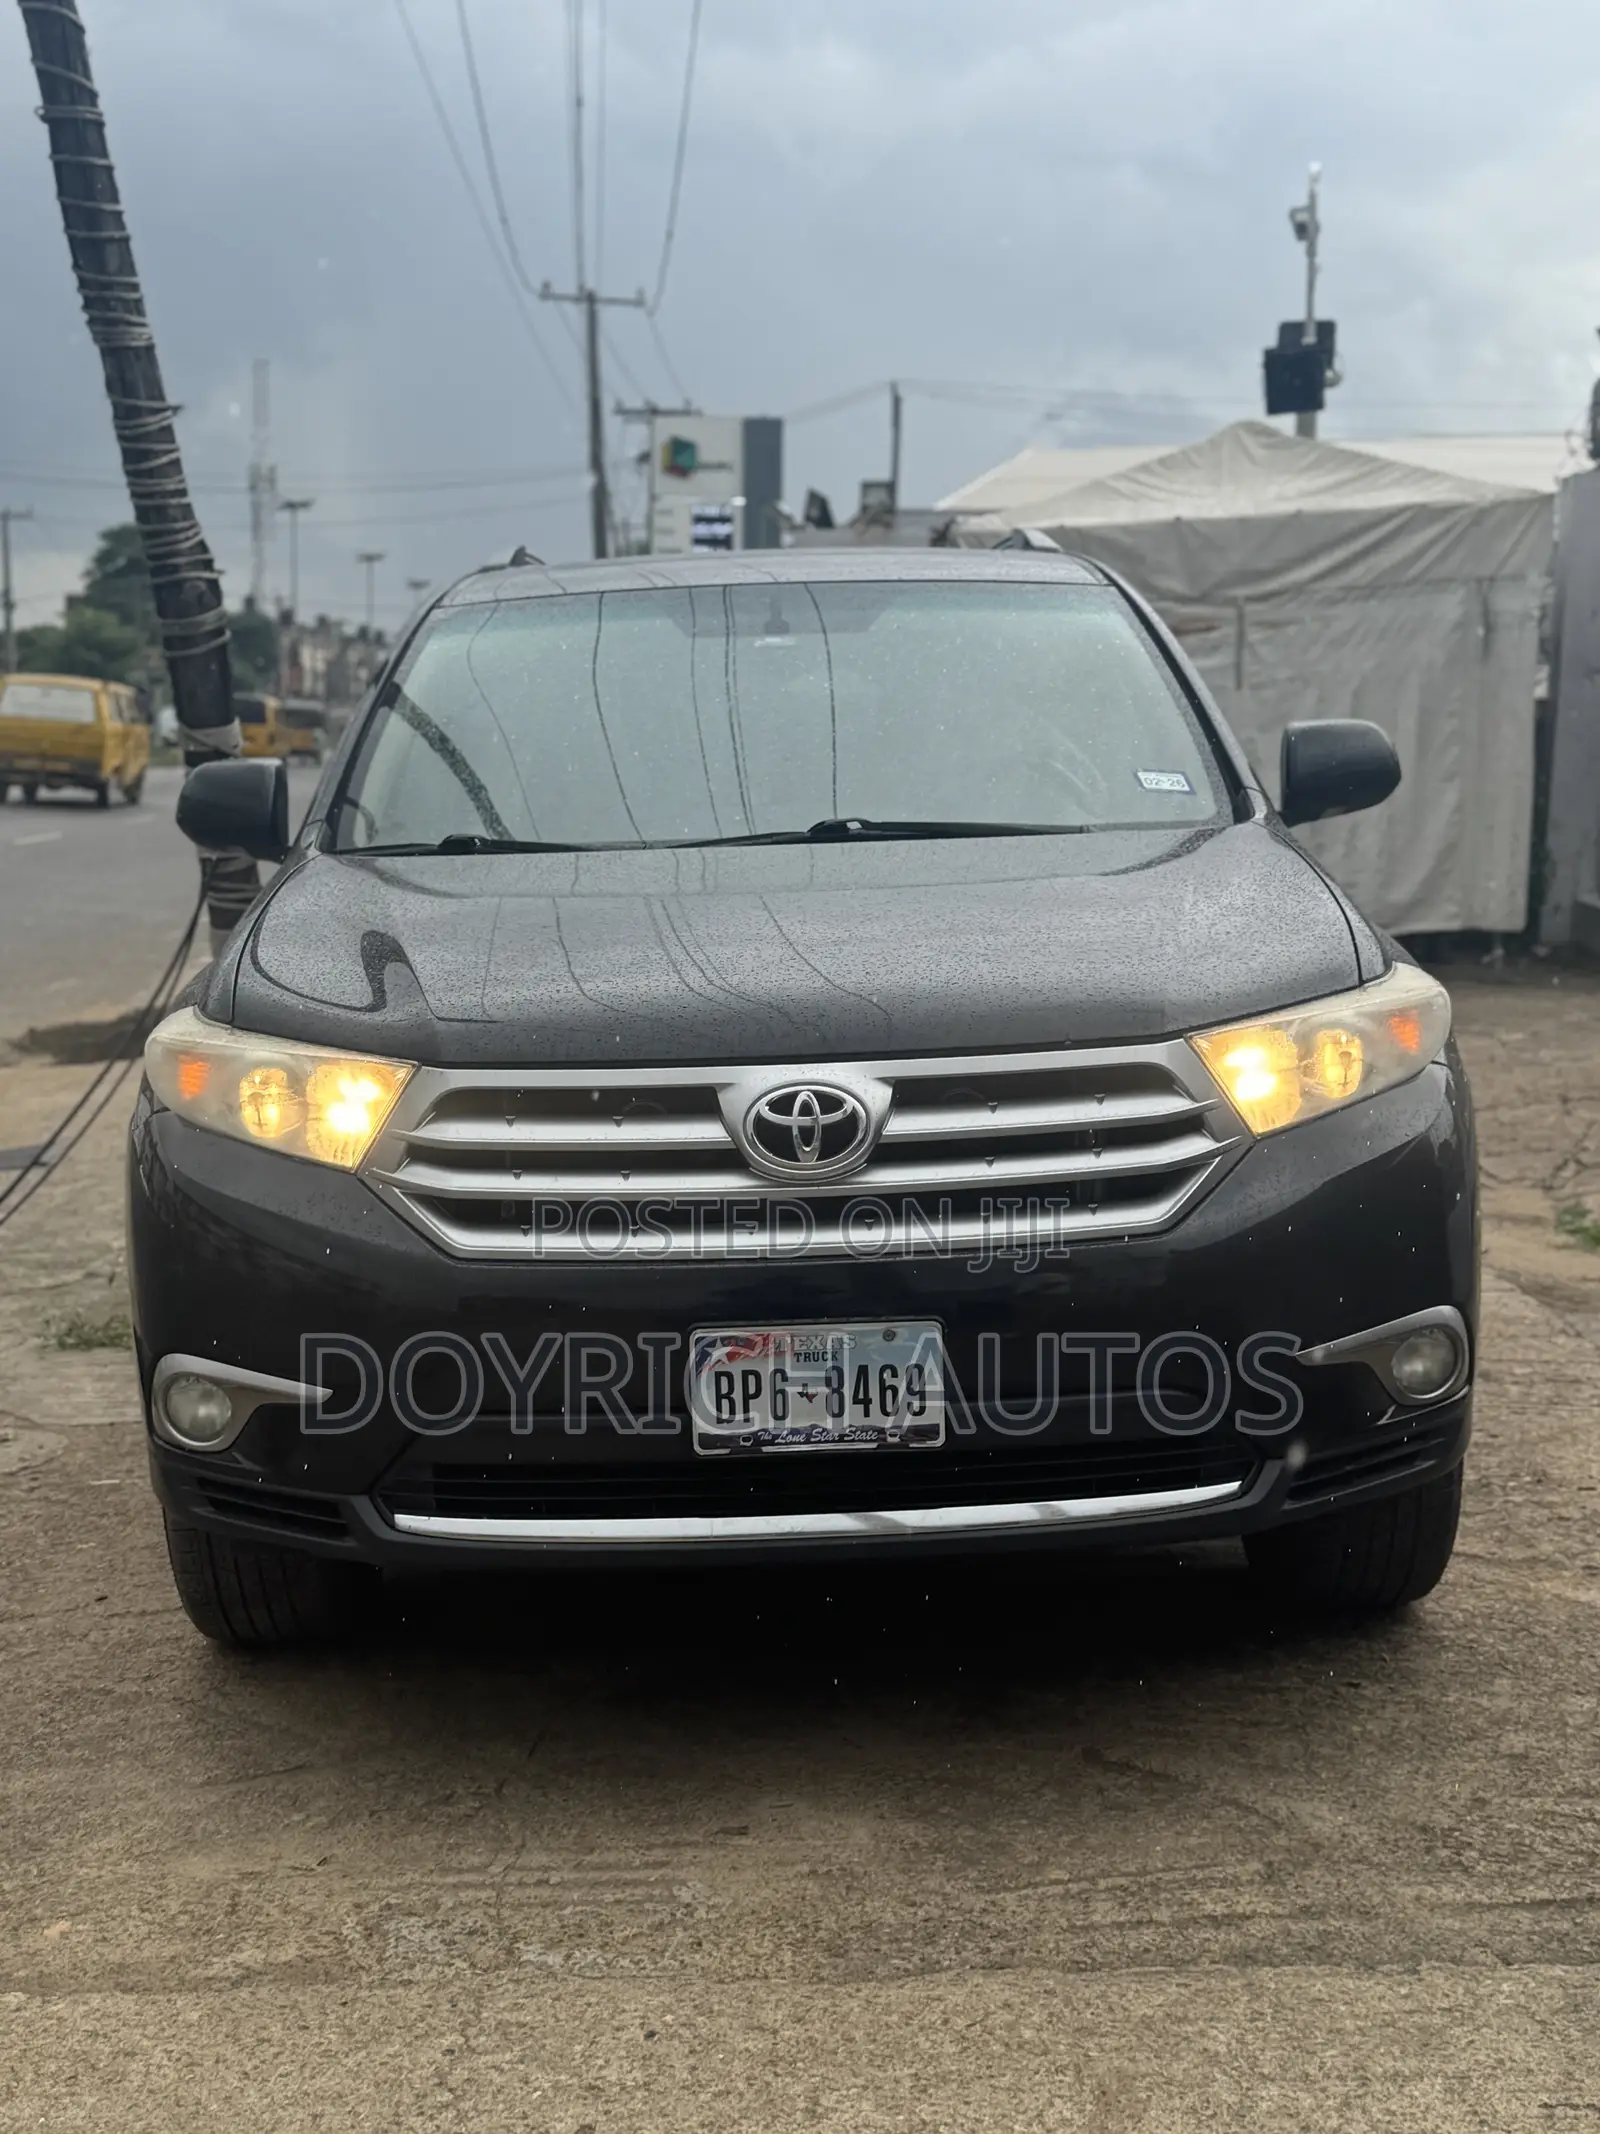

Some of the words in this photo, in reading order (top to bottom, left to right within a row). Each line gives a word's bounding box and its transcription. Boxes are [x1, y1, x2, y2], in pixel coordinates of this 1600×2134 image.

[776, 1333, 858, 1351] TEXAS
[793, 1350, 839, 1363] TRUCK
[713, 1367, 790, 1425] BP6
[824, 1362, 928, 1419] 8469
[757, 1430, 773, 1441] The
[774, 1430, 807, 1444] Lone
[811, 1429, 840, 1442] Star
[843, 1427, 880, 1440] State
